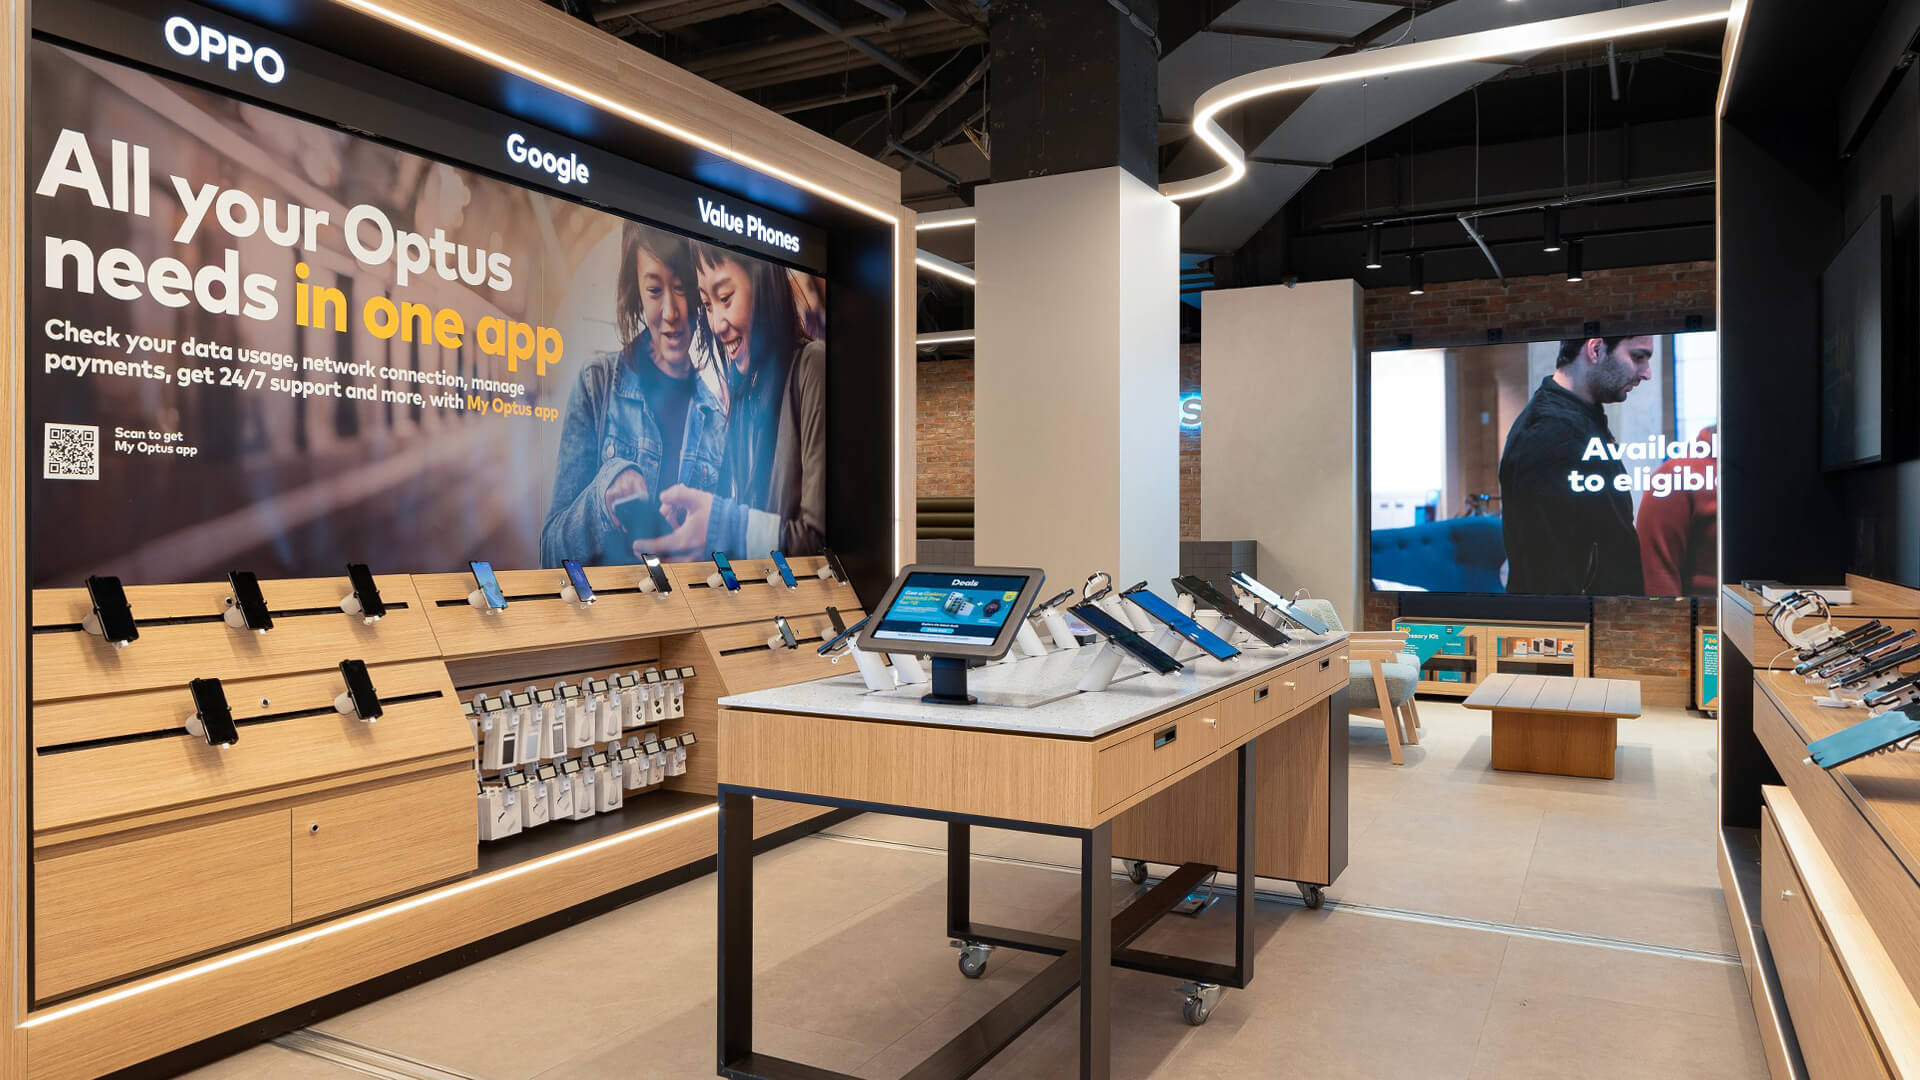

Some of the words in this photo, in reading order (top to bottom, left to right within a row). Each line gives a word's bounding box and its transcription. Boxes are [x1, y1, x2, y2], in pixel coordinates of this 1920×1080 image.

[164, 16, 285, 84] OPPO
[506, 133, 590, 184] Google
[35, 128, 150, 217] All
[170, 175, 330, 253] your
[344, 203, 513, 292] Optus
[697, 197, 744, 234] Value
[746, 214, 801, 253] Phones
[45, 236, 279, 321] needs
[295, 261, 347, 333] in
[362, 295, 465, 350] one
[476, 315, 564, 377] app
[44, 318, 121, 348] Check
[125, 334, 177, 354] your
[181, 336, 233, 361] data
[238, 348, 299, 373] usage,
[302, 355, 377, 379] network
[379, 365, 469, 391] connection,
[471, 378, 526, 398] manage
[44, 352, 172, 384] payments,
[177, 366, 215, 387] get
[219, 366, 267, 391] 24/7
[270, 376, 342, 400] support
[345, 382, 378, 402] and
[381, 390, 427, 409] more,
[429, 393, 465, 410] with
[467, 394, 489, 417] My
[491, 397, 533, 418] Optus
[534, 405, 560, 423] app
[114, 427, 147, 442] Scan
[148, 430, 162, 441] to
[163, 431, 184, 443] get
[114, 440, 135, 455] My
[137, 441, 174, 456] Optus
[175, 446, 199, 458] app
[1567, 470, 1605, 492] to
[1613, 465, 1718, 498] eligibl
[951, 578, 980, 588] Deals
